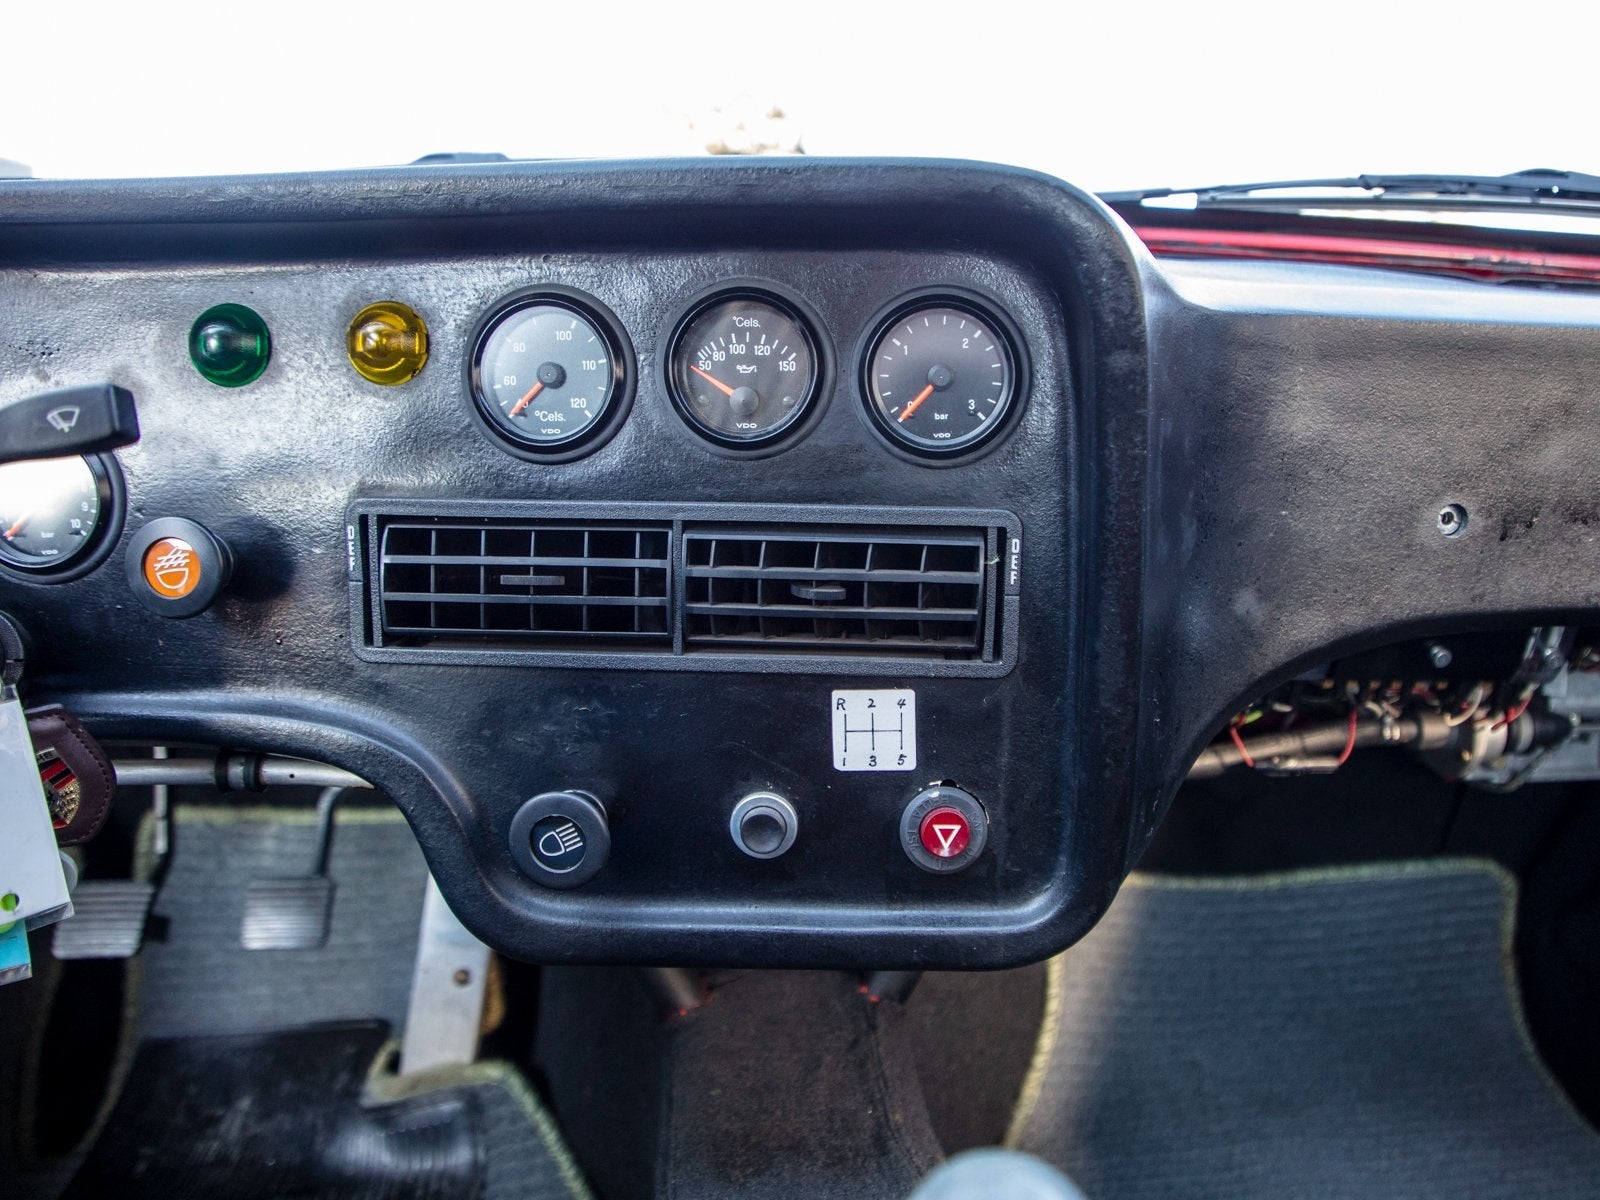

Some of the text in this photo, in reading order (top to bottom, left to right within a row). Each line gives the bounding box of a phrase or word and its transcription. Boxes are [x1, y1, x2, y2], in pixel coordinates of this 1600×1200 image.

[555, 331, 572, 341] 100
[513, 342, 526, 352] 80
[962, 338, 969, 348] 2
[903, 345, 908, 355] 1
[698, 344, 796, 371] 50 80 100 120 150
[582, 360, 596, 370] 110
[504, 376, 517, 385] 60
[570, 398, 587, 408] 120
[968, 399, 975, 410] 3
[934, 412, 949, 420] bar
[81, 502, 89, 511] 9
[70, 518, 81, 528] 10
[1010, 538, 1020, 585] DEF
[836, 698, 906, 710] R 2 4
[868, 755, 877, 767] 3
[897, 754, 907, 765] 5
